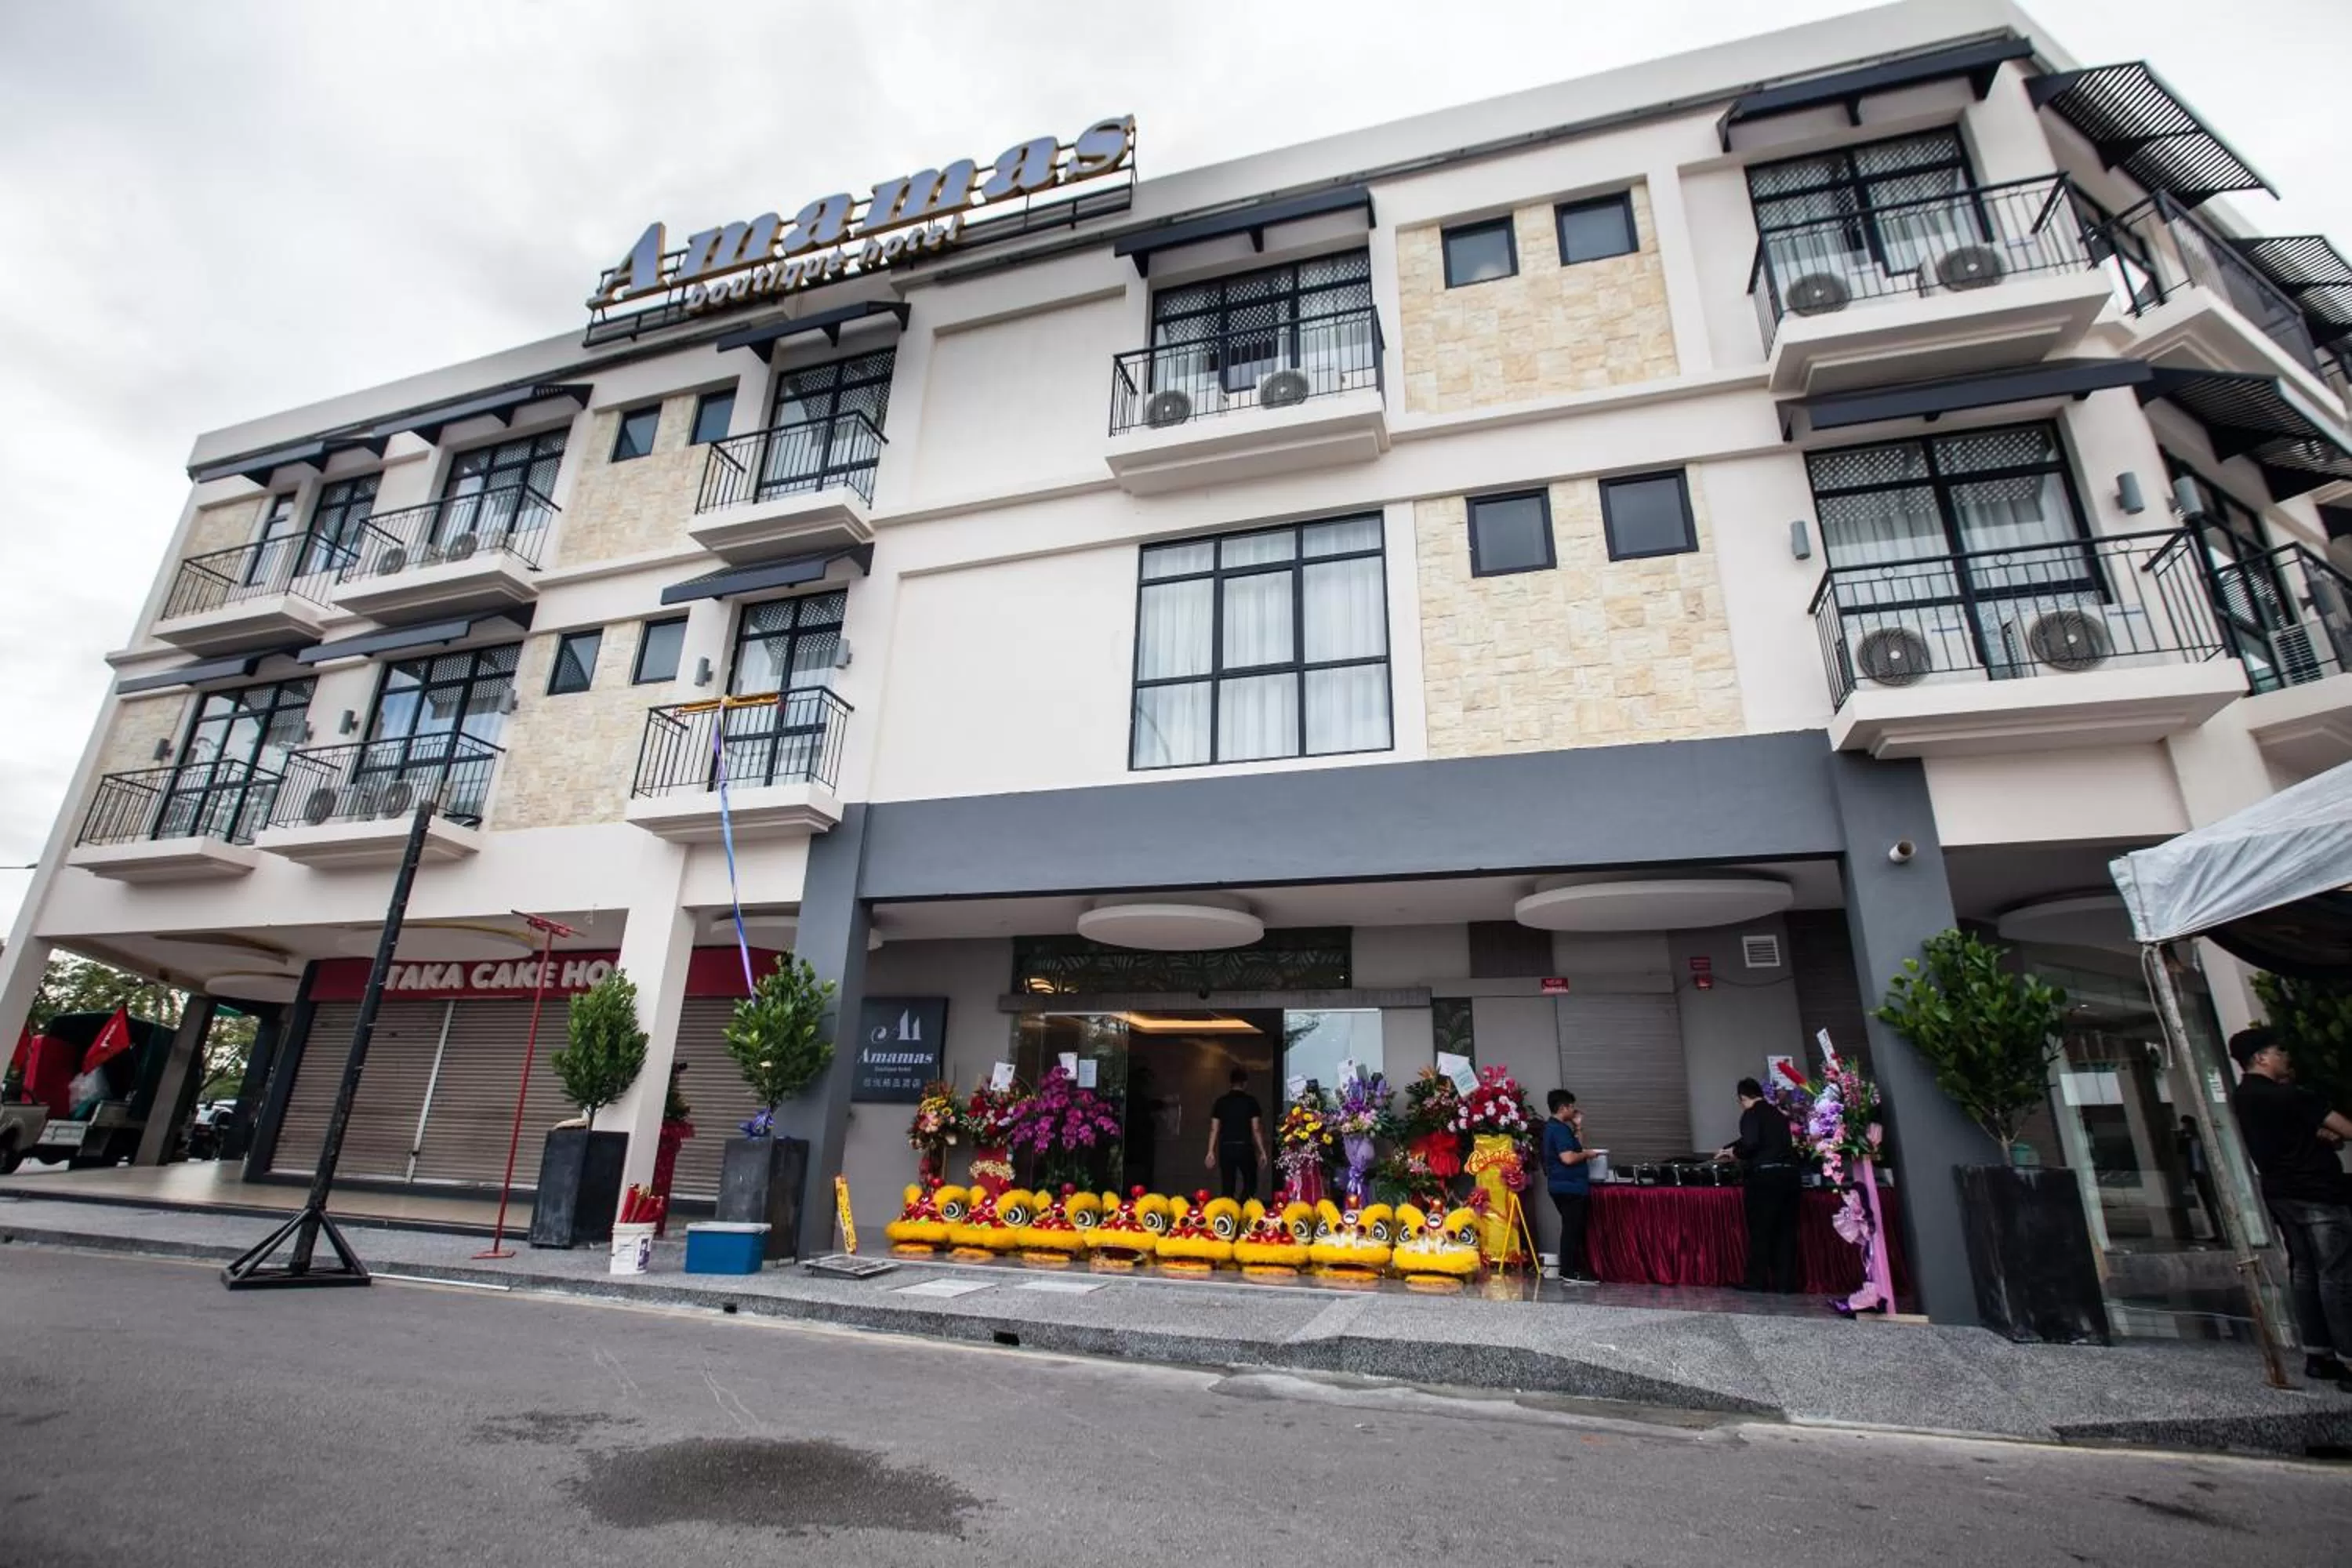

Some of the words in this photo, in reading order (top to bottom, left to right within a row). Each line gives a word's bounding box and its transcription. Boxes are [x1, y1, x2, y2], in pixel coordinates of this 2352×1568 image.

[586, 114, 1134, 307] Amamas
[684, 249, 847, 310] boutique
[859, 212, 964, 266] hotel
[385, 963, 464, 990] TAKA
[470, 961, 558, 989] CAKE
[561, 959, 619, 988] HO
[857, 1047, 934, 1064] Amamas
